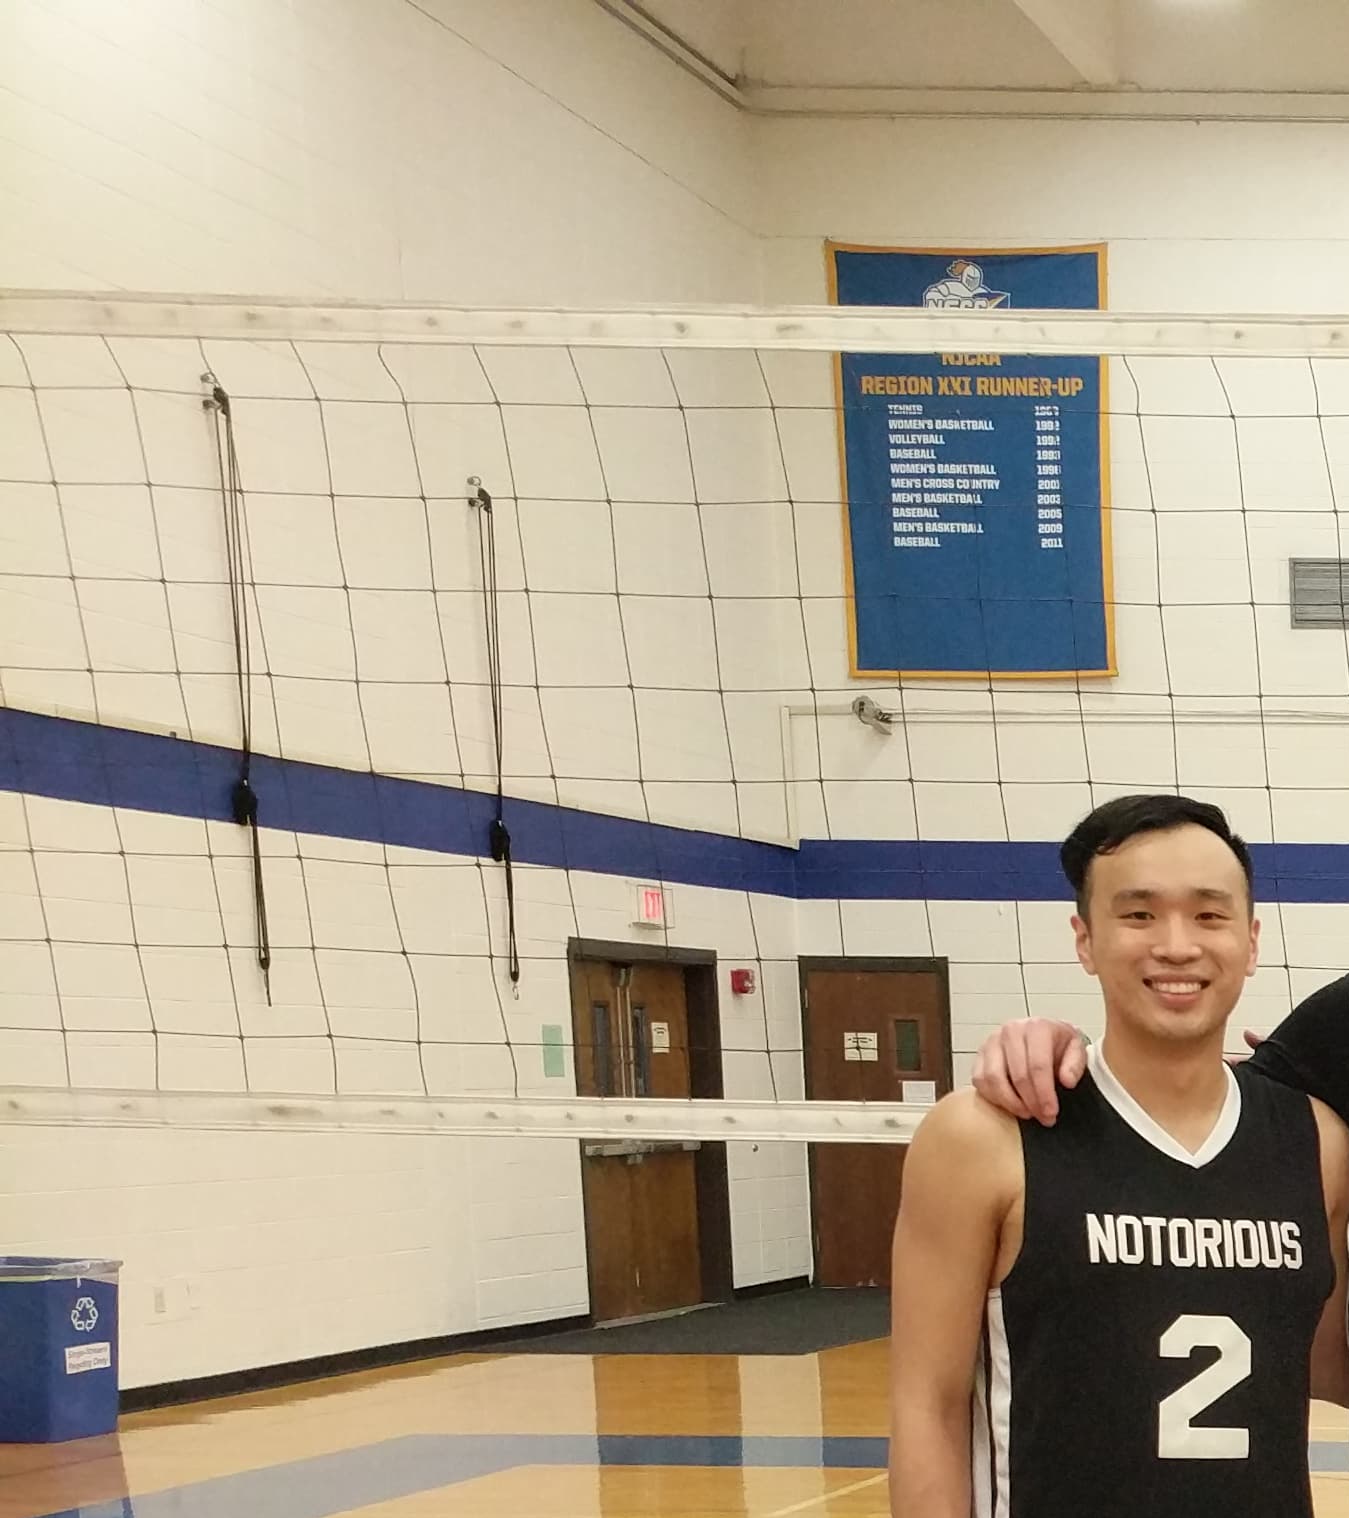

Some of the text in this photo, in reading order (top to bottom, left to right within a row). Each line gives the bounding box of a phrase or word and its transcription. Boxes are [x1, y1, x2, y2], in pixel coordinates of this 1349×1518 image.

[861, 376, 1084, 397] REGION XXI RUNNER-UP
[888, 419, 934, 430] WOMEN'S
[935, 419, 995, 431] BASKETBALL
[888, 433, 946, 445] VOLLEYBALL
[889, 449, 937, 459] BASEBALL
[890, 463, 936, 474] WOMEN'S
[937, 464, 997, 475] BASKETBALL
[891, 478, 922, 489] MEN'S
[923, 478, 955, 489] CROSS
[956, 479, 1001, 490] COUNTRY
[892, 493, 922, 504] MEN'S
[924, 493, 983, 504] BASKETBALL
[892, 507, 940, 518] BASEBALL
[893, 522, 924, 533] MEN'S
[925, 523, 984, 533] BASKETBALL
[893, 537, 1064, 548] BASEBALL 2011
[1085, 1212, 1303, 1270] NOTORIOUS
[1157, 1314, 1252, 1460] 2
